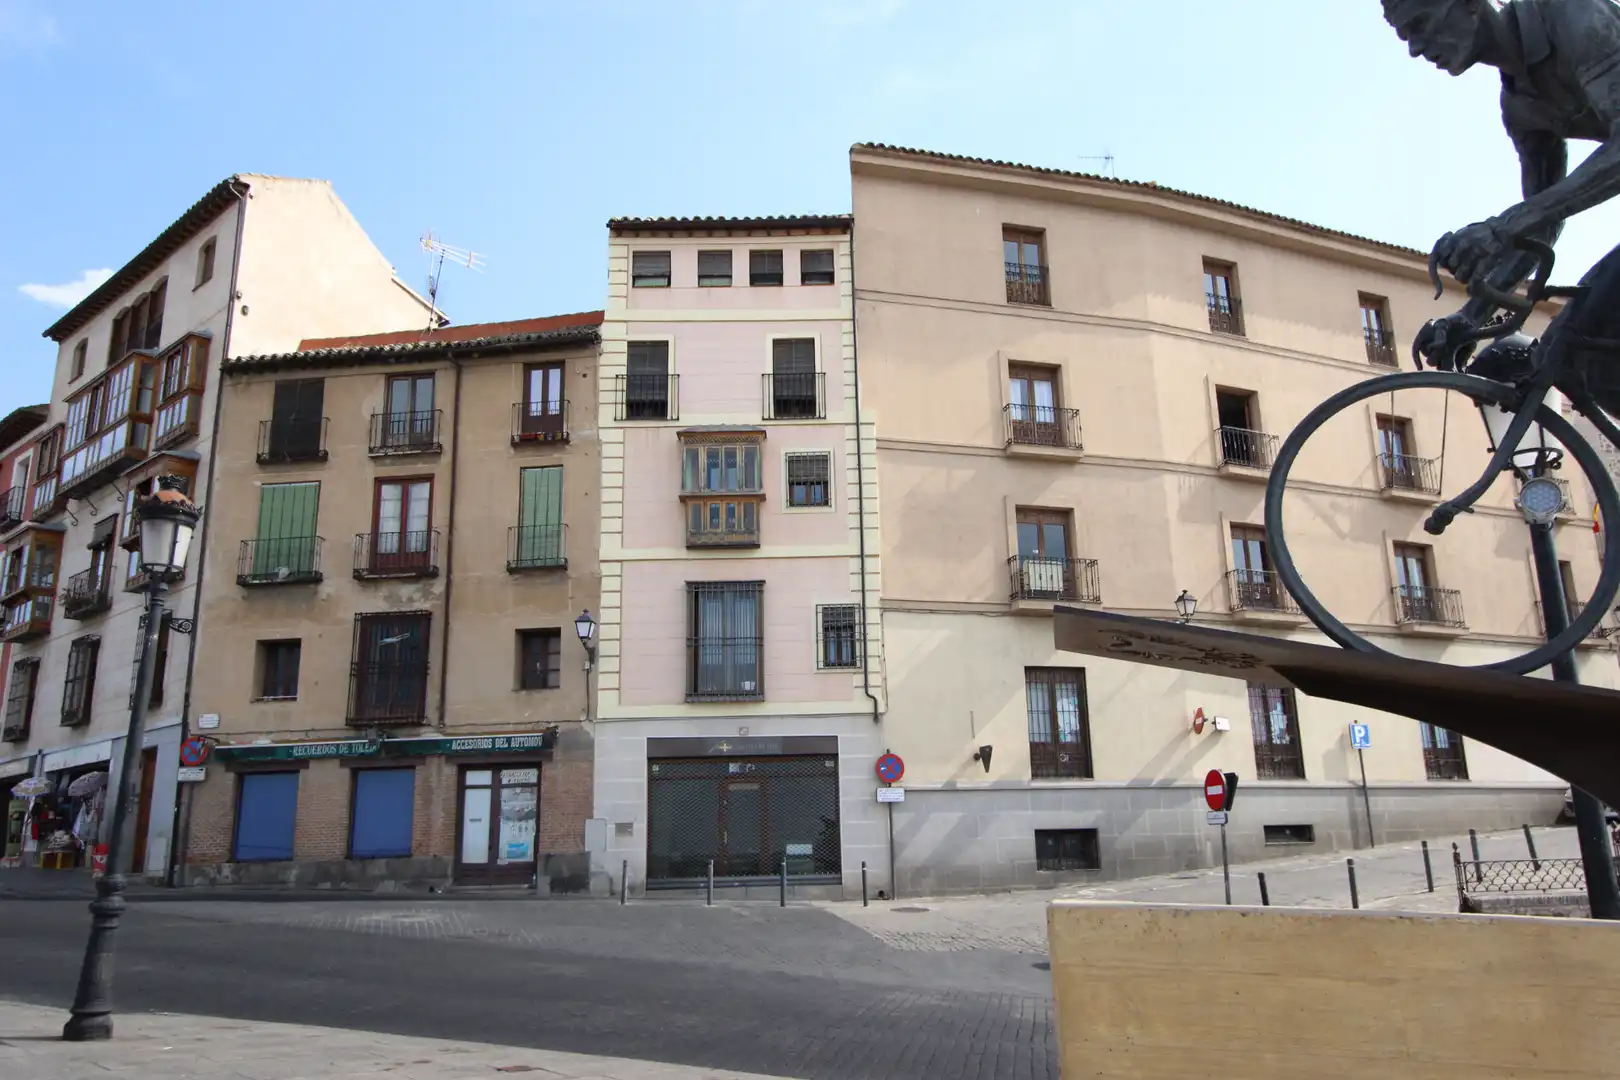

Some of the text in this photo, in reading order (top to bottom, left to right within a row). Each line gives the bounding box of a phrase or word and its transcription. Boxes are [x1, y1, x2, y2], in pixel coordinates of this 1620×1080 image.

[1354, 725, 1366, 743] P
[293, 743, 337, 756] RECUERDOS
[339, 743, 349, 754] DE
[451, 738, 493, 750] ACCESORIOS
[495, 737, 508, 748] DEL
